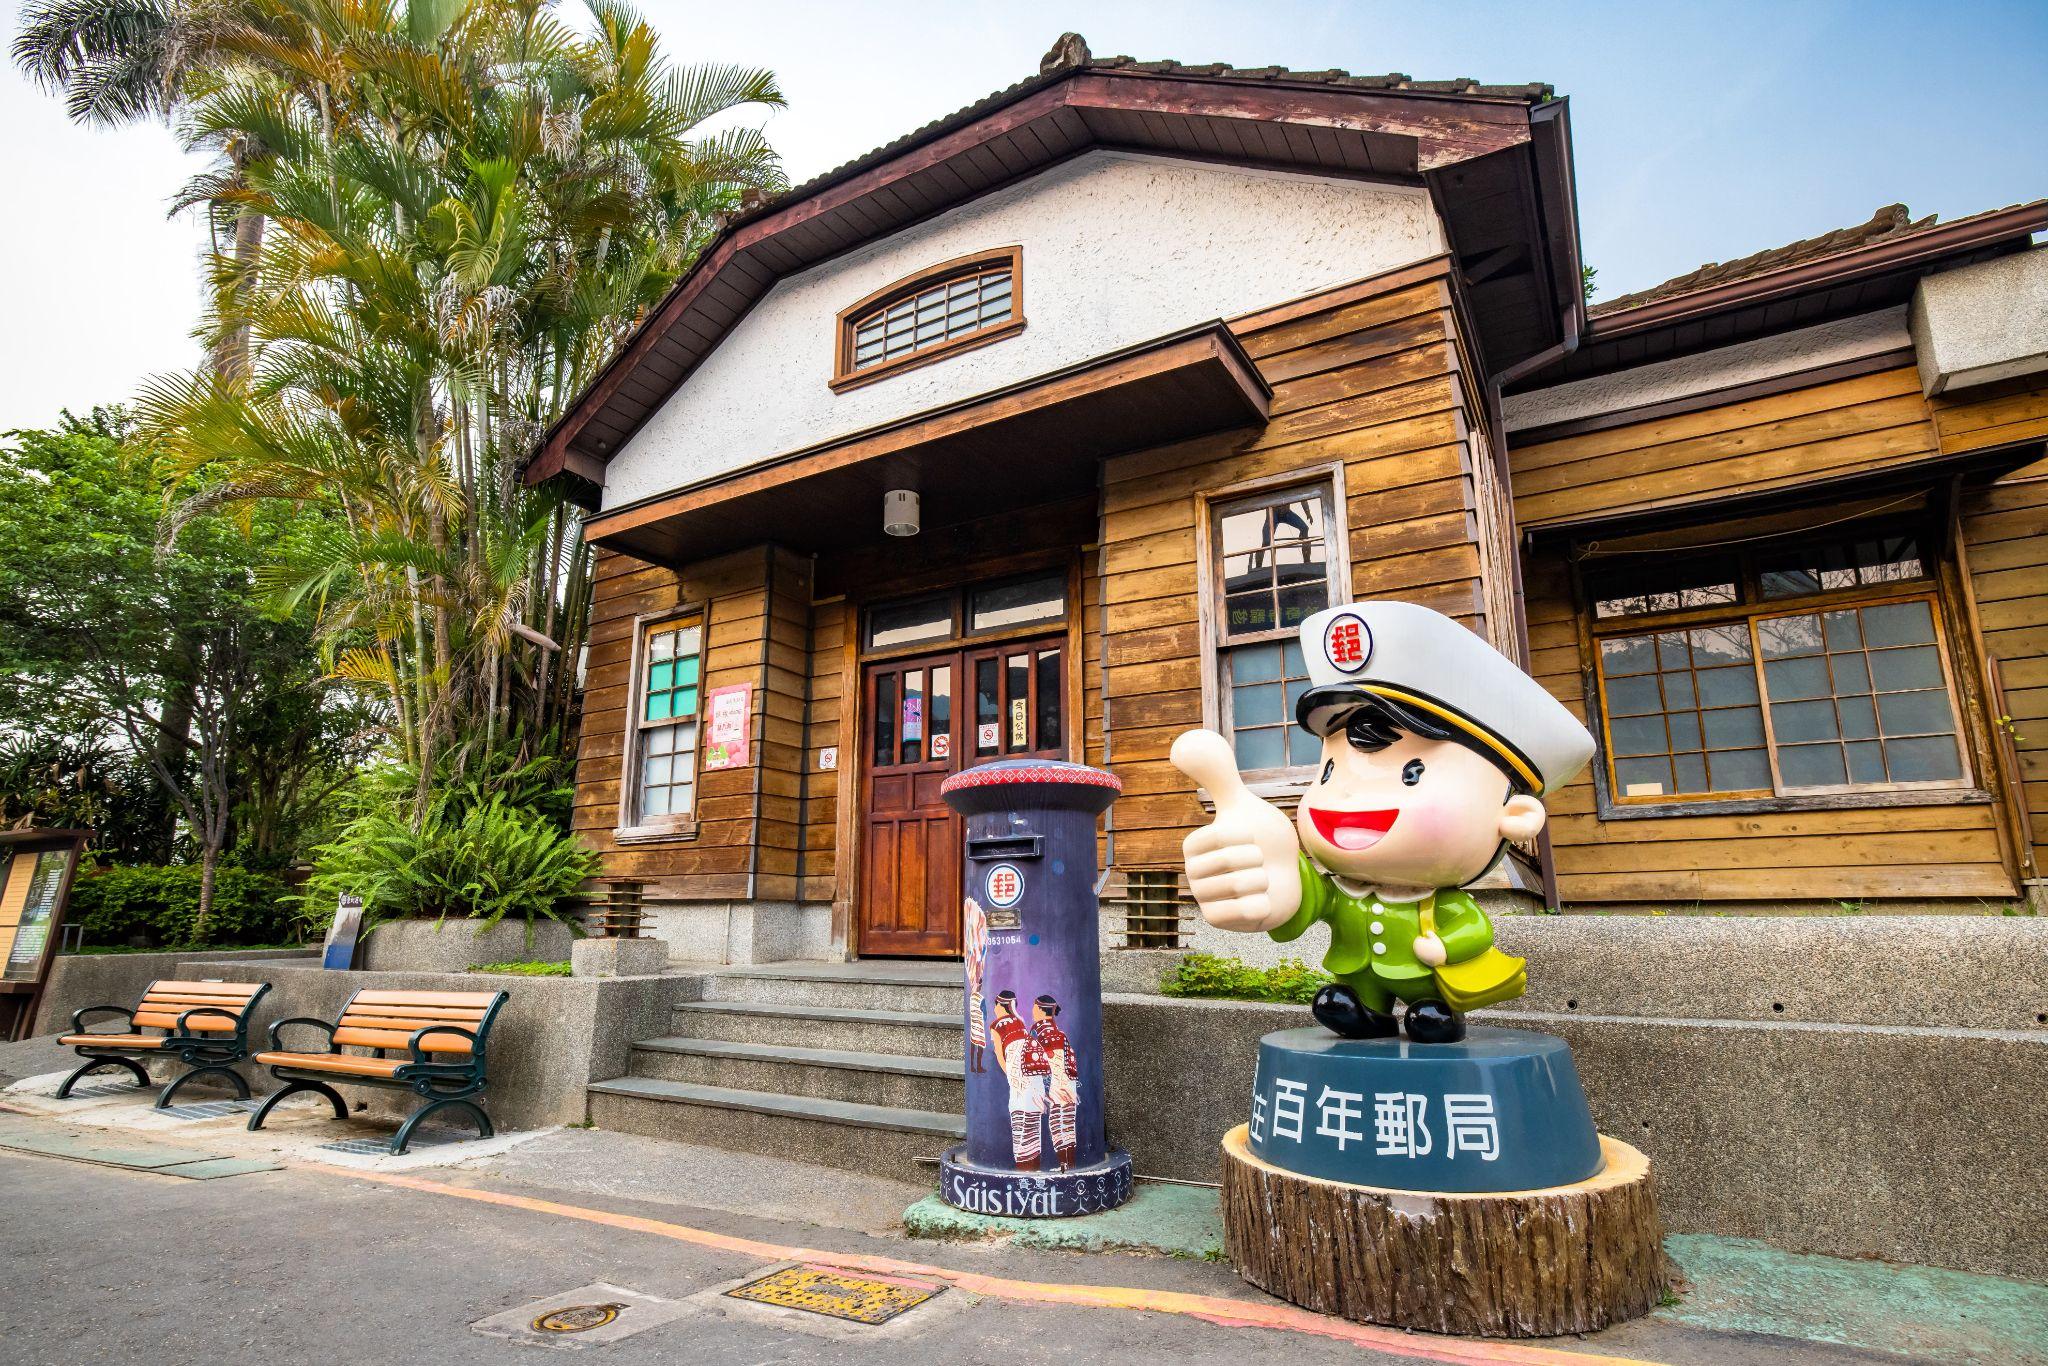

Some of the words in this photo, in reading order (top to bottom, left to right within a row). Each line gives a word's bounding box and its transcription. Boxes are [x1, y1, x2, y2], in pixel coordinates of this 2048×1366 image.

[1331, 623, 1363, 662] 郵
[1015, 701, 1024, 741] 今日公休
[993, 873, 1015, 897] 郵
[1250, 1056, 1500, 1161] 庄百年郵局
